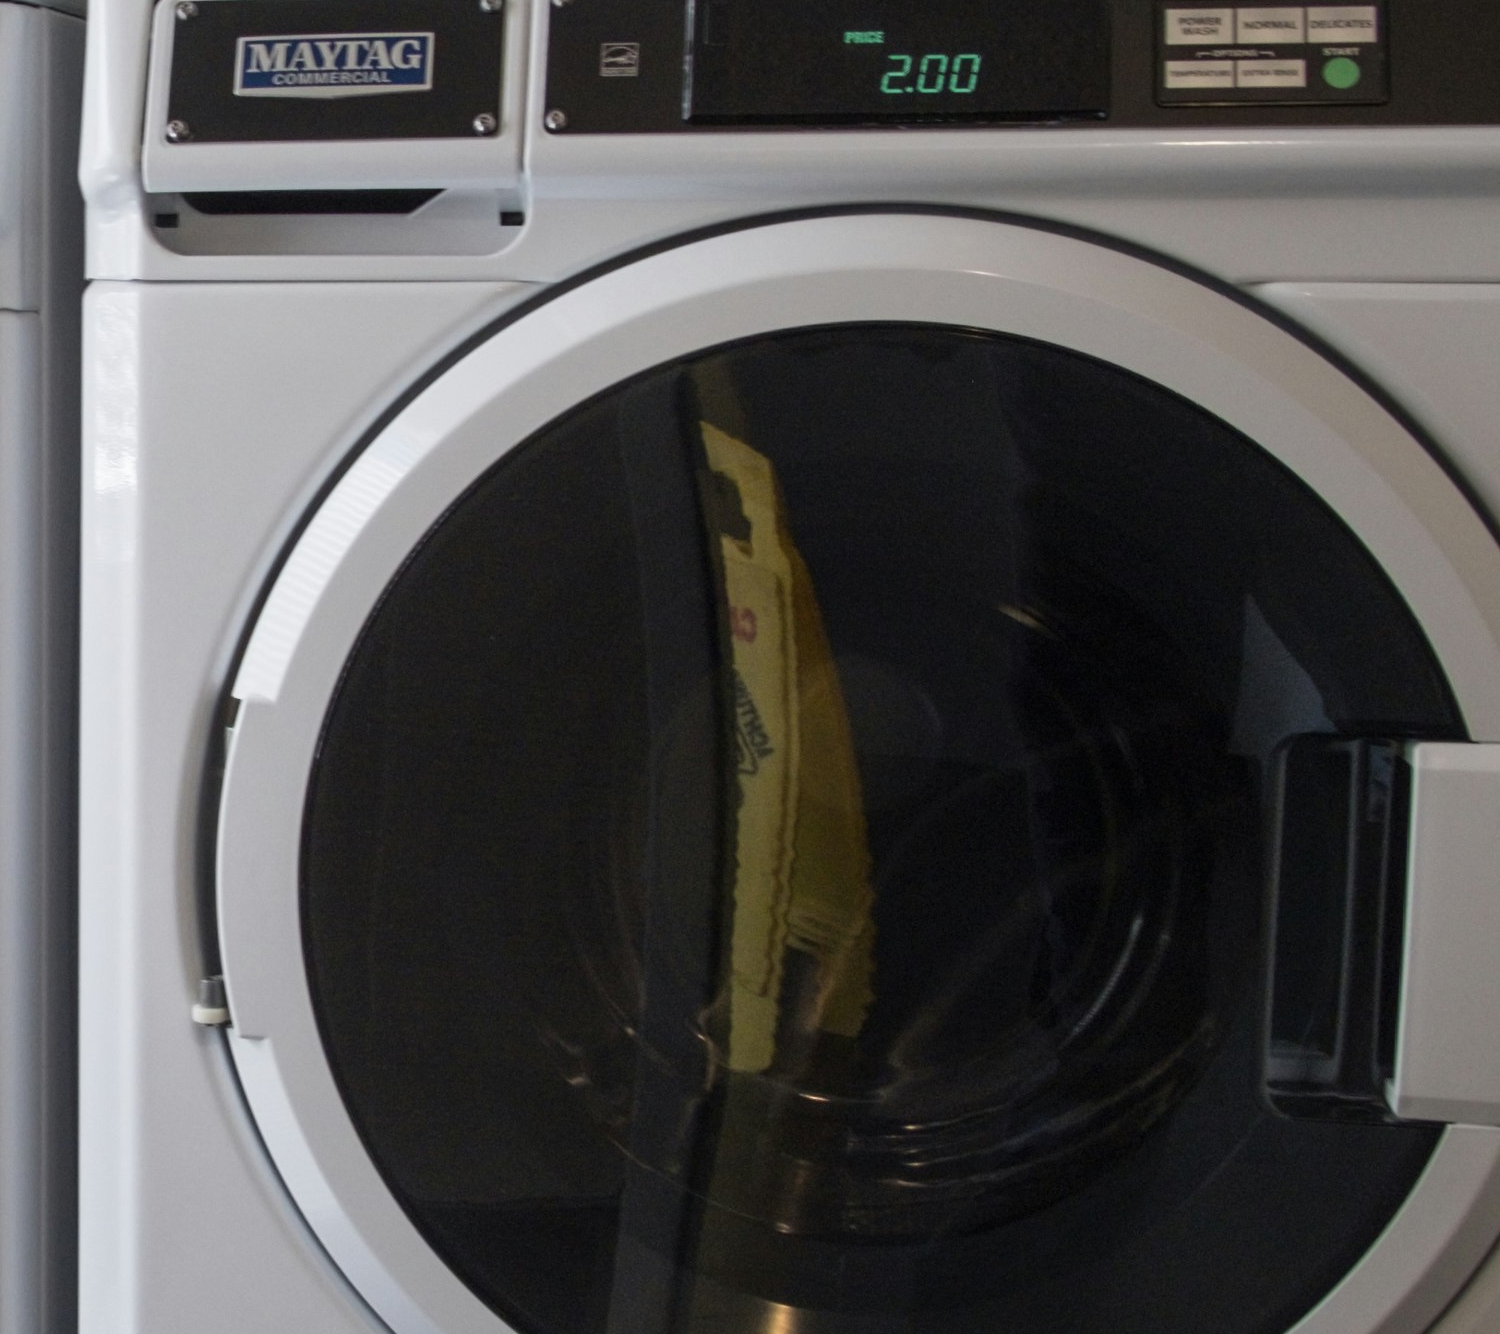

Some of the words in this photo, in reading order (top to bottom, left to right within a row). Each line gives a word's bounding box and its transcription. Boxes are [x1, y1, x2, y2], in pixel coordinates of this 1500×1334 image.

[1243, 21, 1297, 29] NORMAL
[1310, 19, 1373, 28] DELICATES
[246, 40, 422, 73] MAYTAG
[271, 71, 392, 85] COMMERCIAL
[880, 54, 981, 93] 2.00
